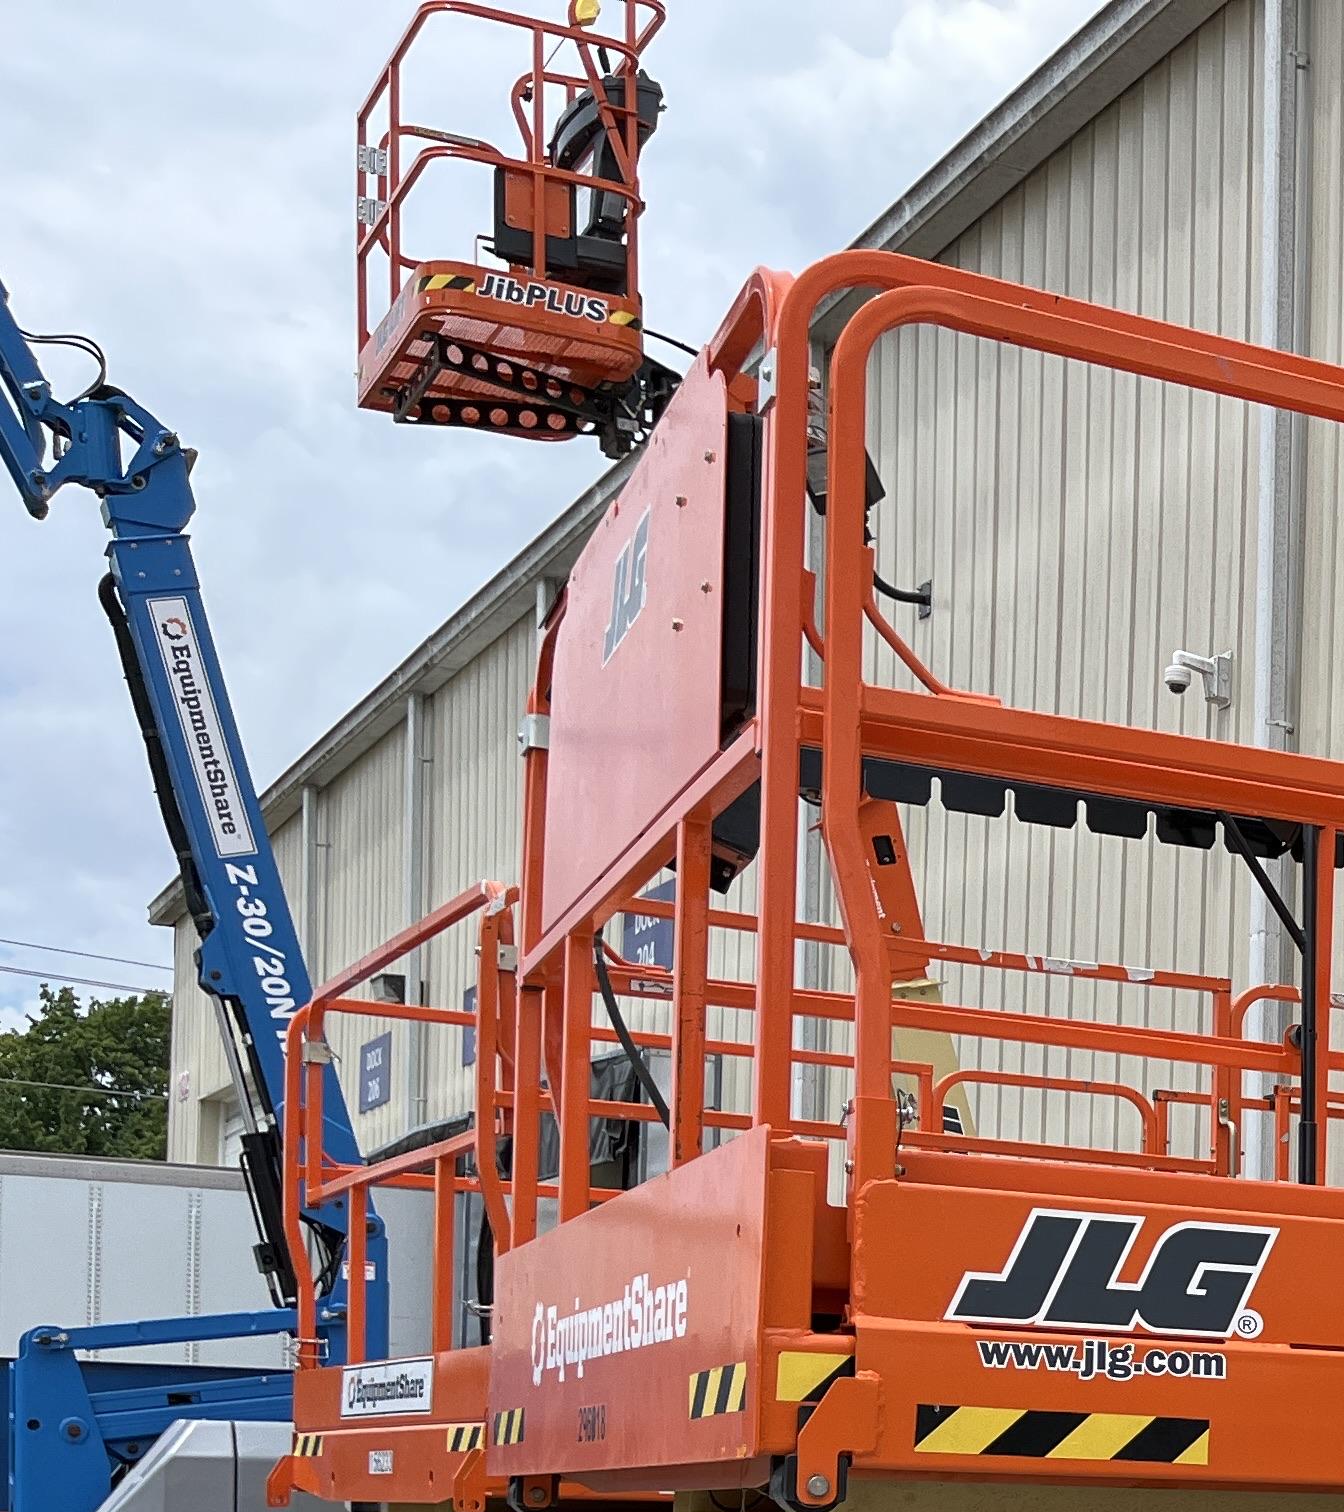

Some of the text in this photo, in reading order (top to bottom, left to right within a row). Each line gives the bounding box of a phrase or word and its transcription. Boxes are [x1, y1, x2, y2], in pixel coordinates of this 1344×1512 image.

[476, 274, 609, 323] JibPLUS
[601, 503, 651, 671] JLG
[171, 643, 237, 836] EquipmentShare
[366, 1047, 383, 1071] DOCK
[944, 1208, 1279, 1337] JLG
[546, 1273, 688, 1382] EquipmentShare
[976, 1338, 1226, 1381] www.jlg.com
[357, 1373, 424, 1408] EquipmentShare
